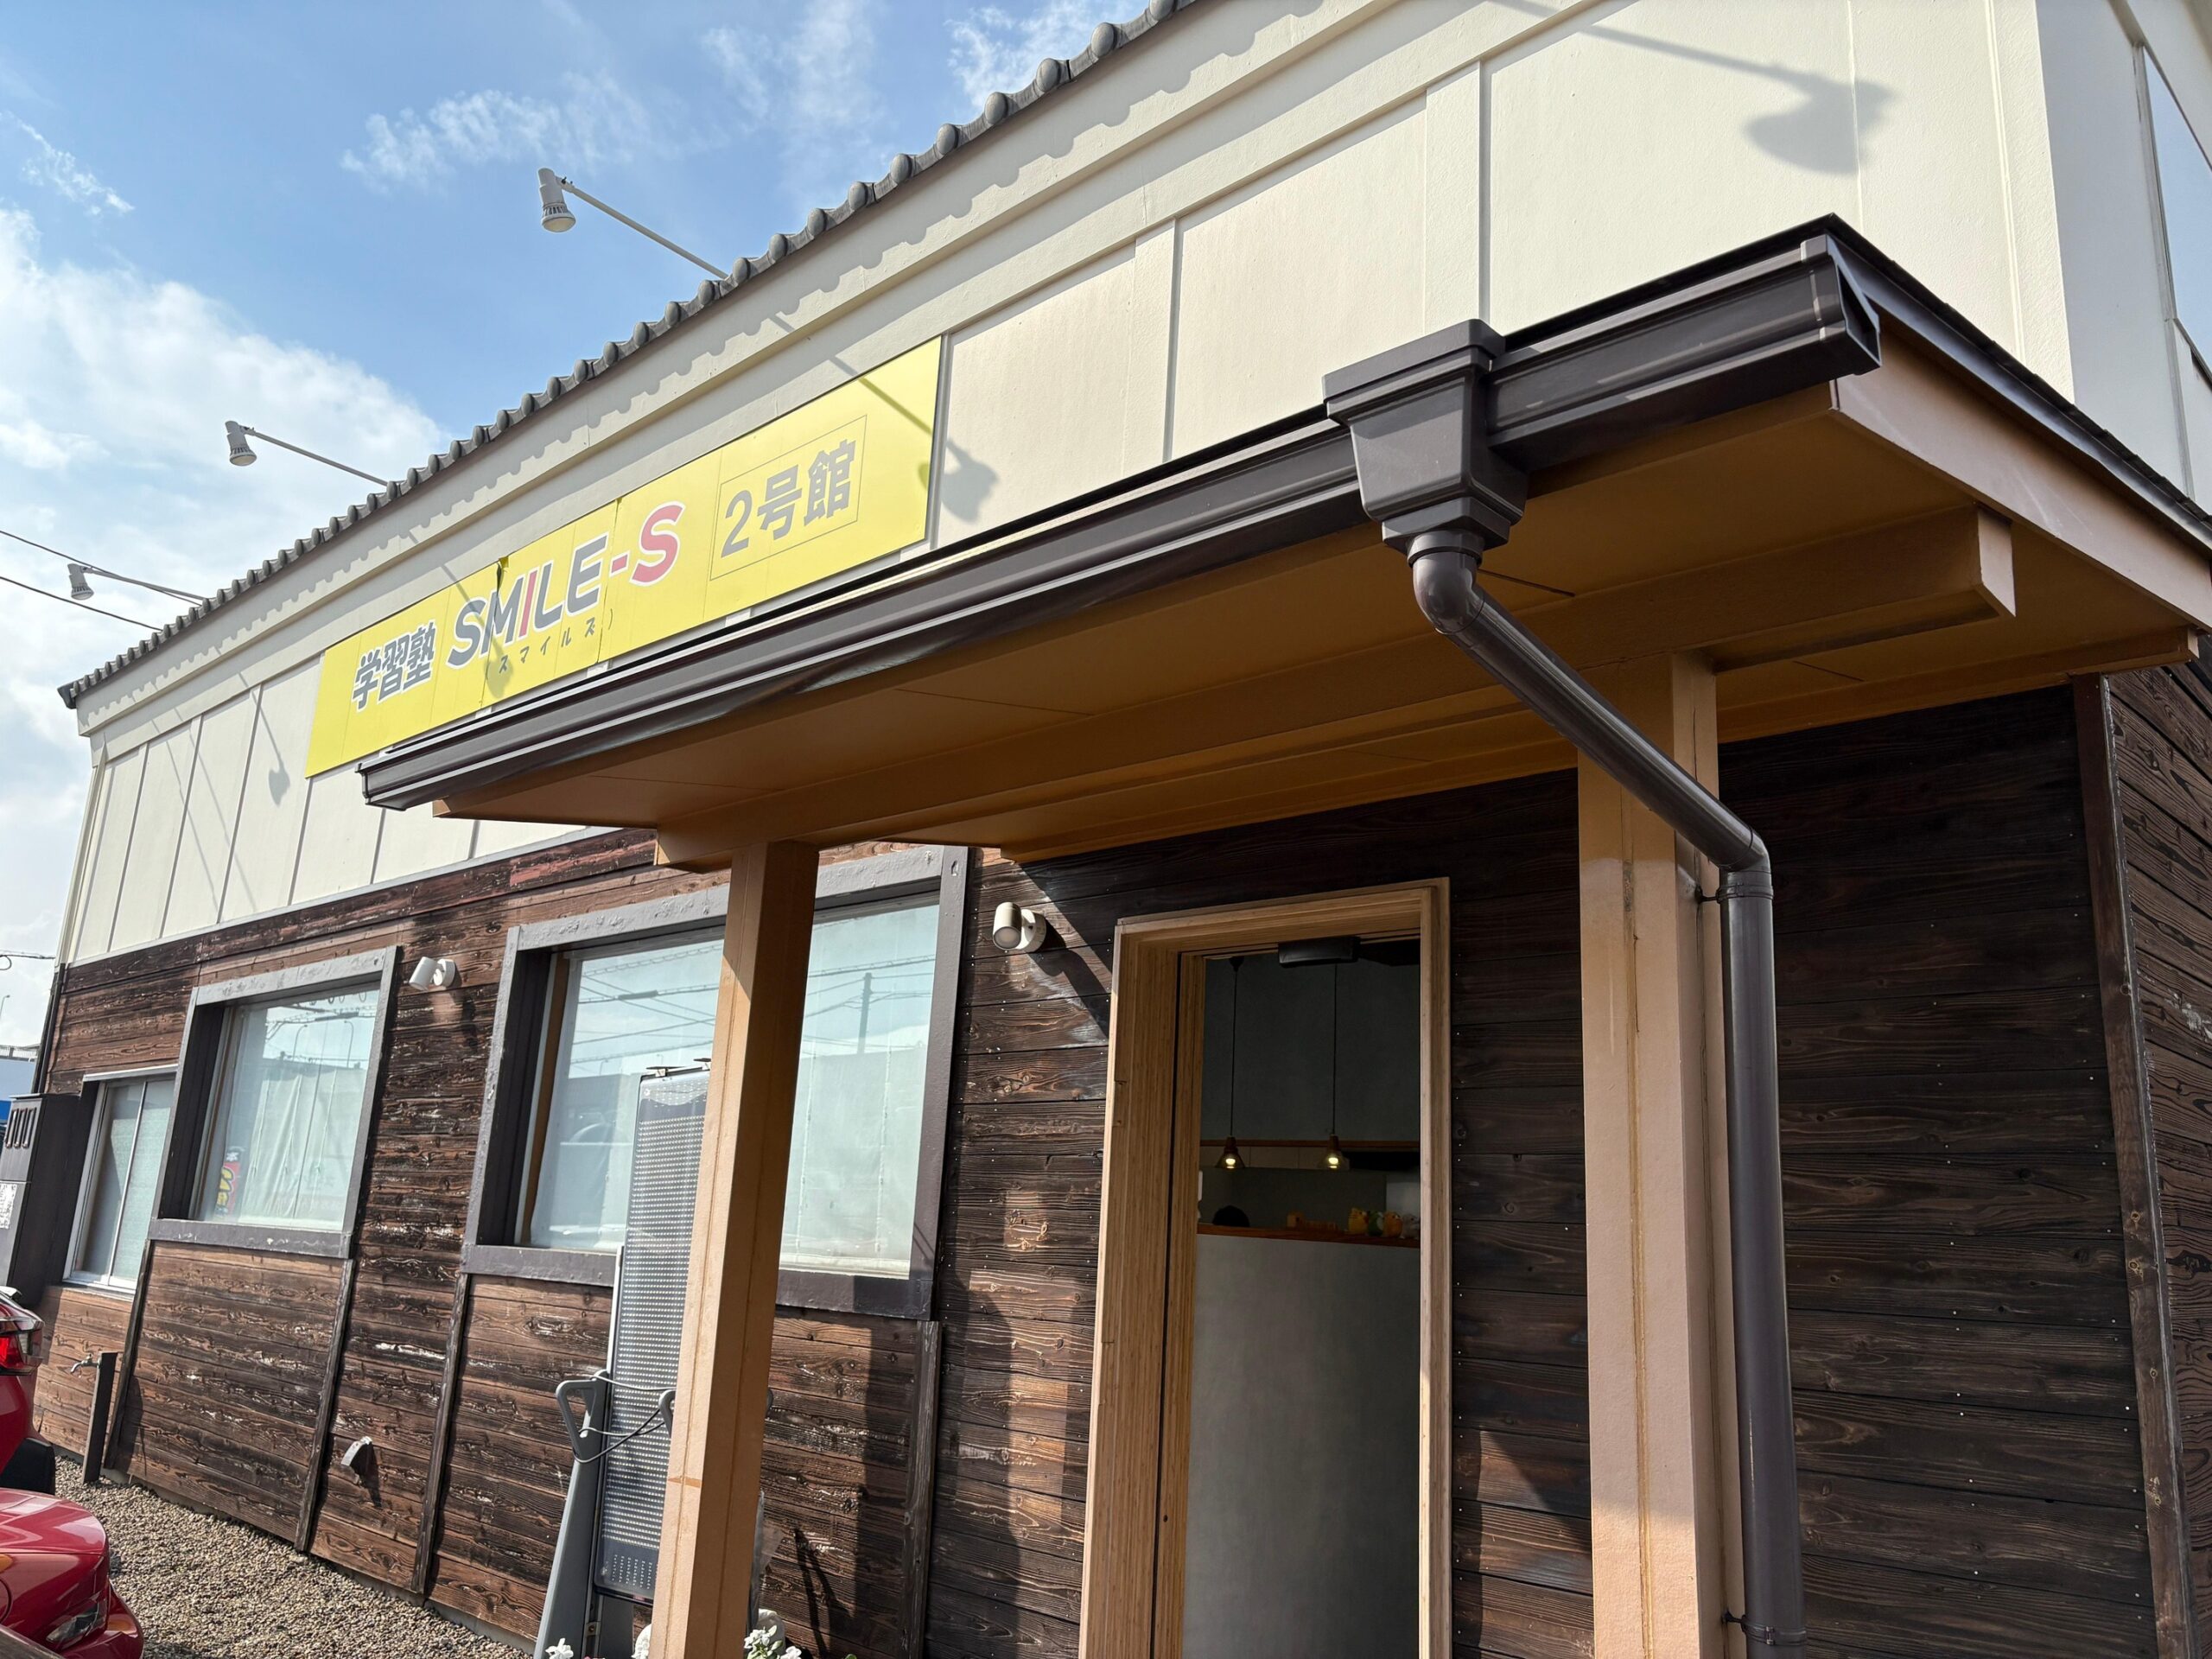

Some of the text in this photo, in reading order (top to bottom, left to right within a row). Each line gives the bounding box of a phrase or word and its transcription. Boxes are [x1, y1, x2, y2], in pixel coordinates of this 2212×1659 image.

[721, 439, 856, 558] 2号館
[446, 504, 685, 668] SMILE-S
[352, 621, 435, 710] 学習塾
